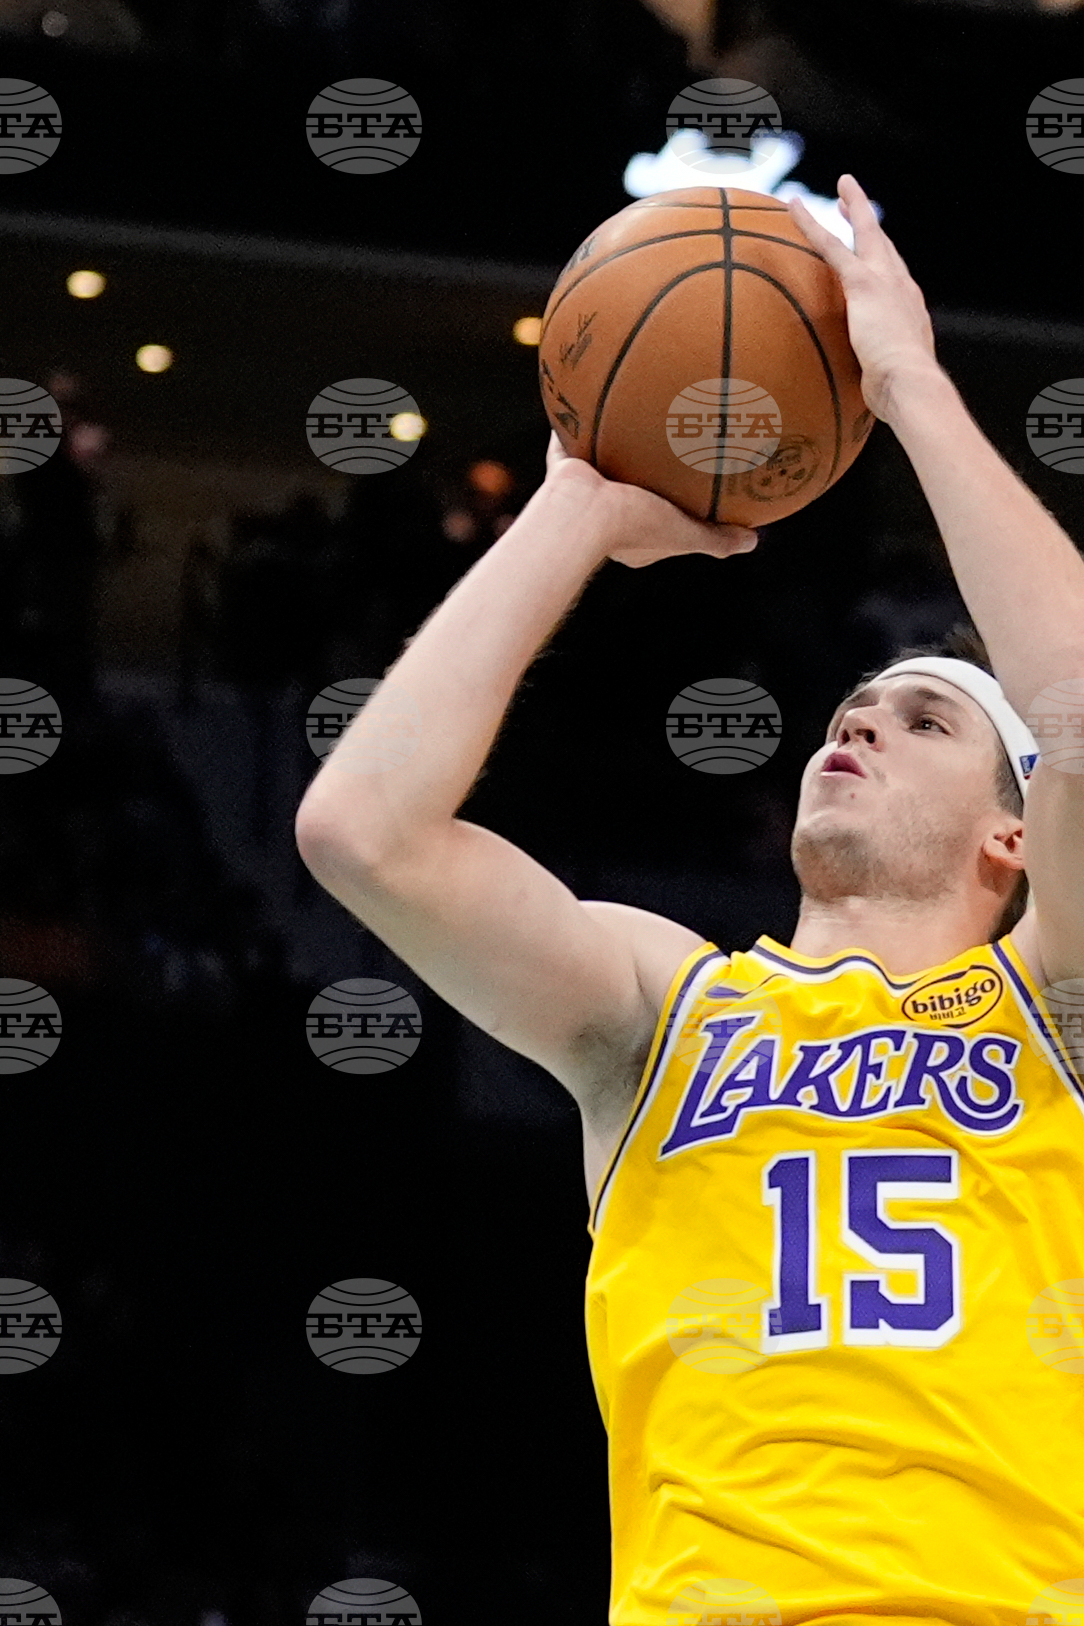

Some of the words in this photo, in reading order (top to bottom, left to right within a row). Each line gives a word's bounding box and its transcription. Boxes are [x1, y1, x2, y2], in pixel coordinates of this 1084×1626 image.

[911, 979, 996, 1014] bibigo
[657, 1010, 1024, 1162] LAKERS
[760, 1150, 962, 1355] 15
